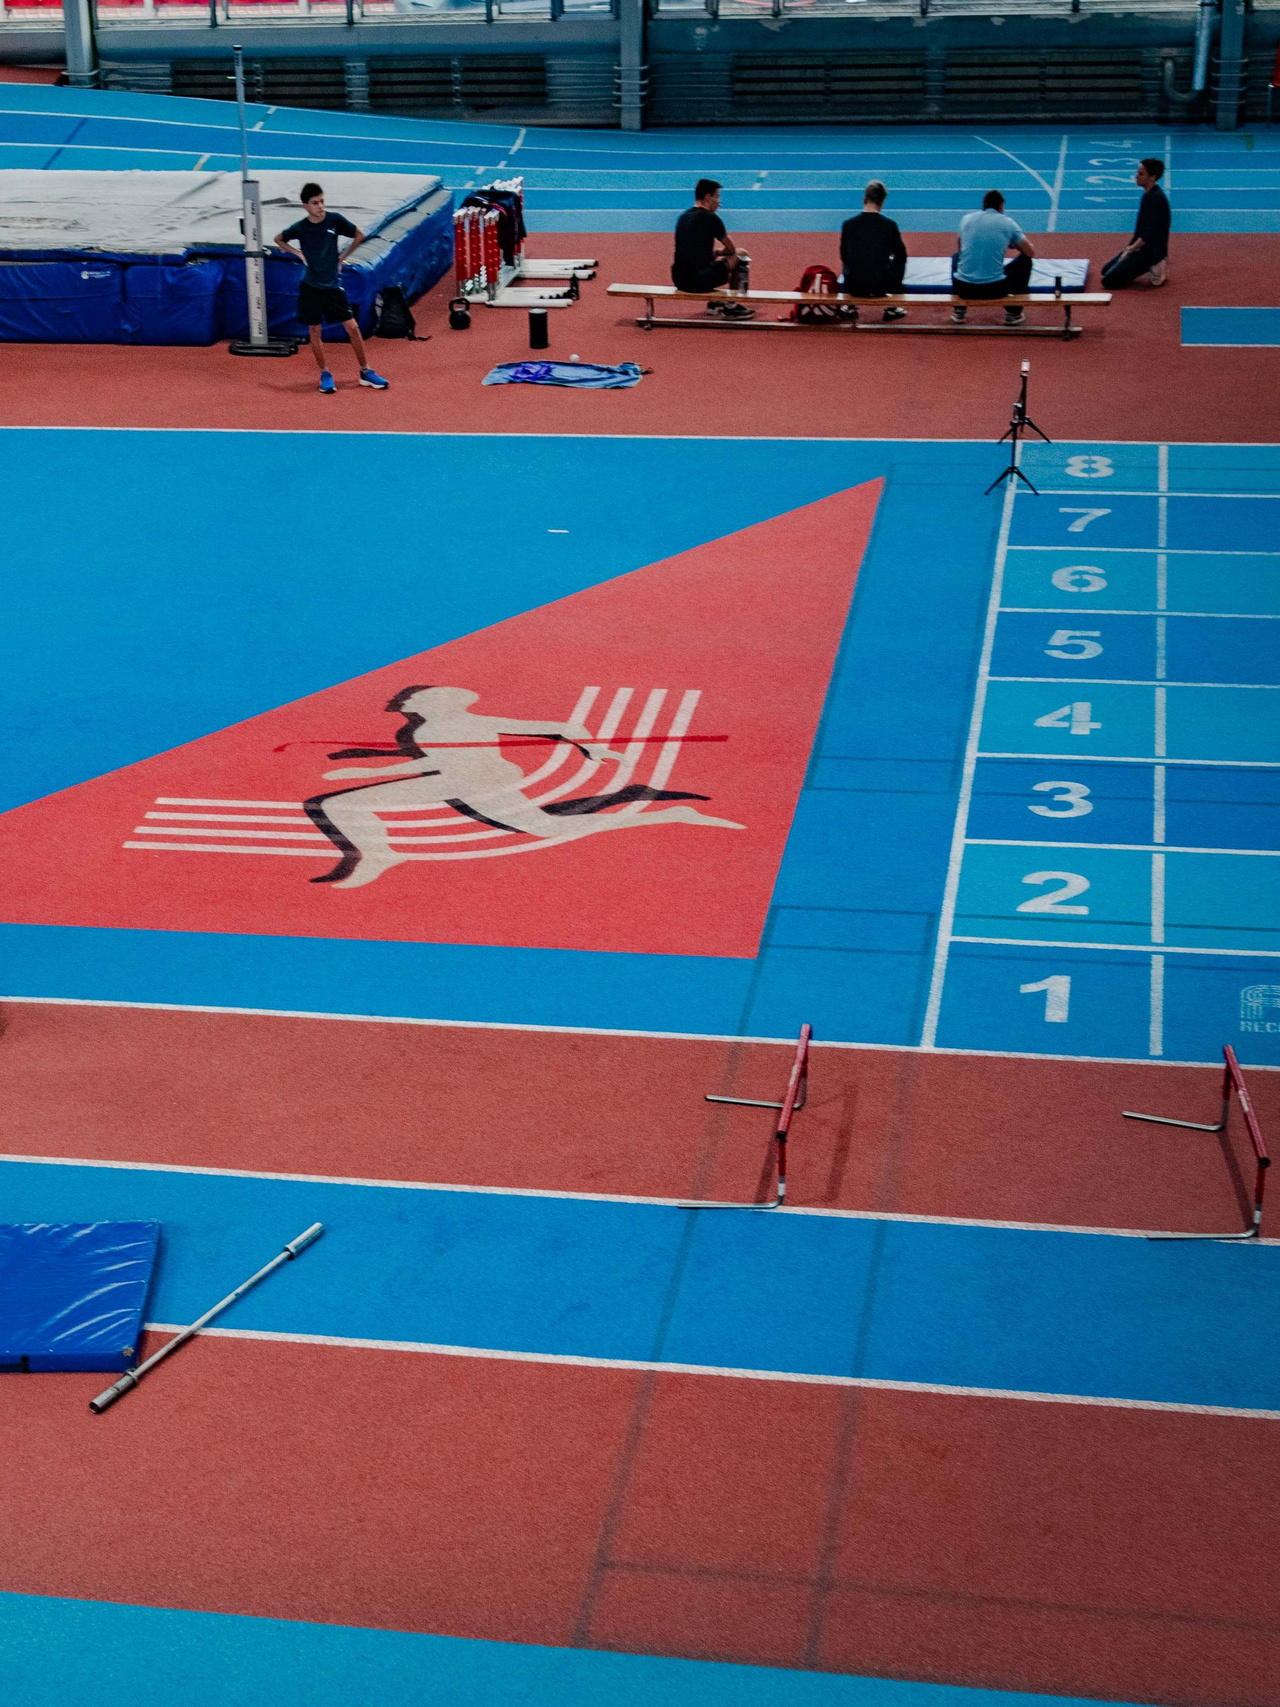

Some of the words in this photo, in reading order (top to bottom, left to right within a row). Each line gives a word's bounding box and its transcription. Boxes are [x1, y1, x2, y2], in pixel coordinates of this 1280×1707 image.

[1065, 455, 1115, 478] 8
[1059, 507, 1112, 532] 7
[1051, 565, 1108, 593] 6
[1043, 629, 1104, 660] 5
[1033, 701, 1102, 735] 4
[1027, 781, 1094, 818] 3
[1016, 870, 1091, 915] 2
[1019, 975, 1071, 1023] 1
[1240, 1020, 1280, 1033] REC
